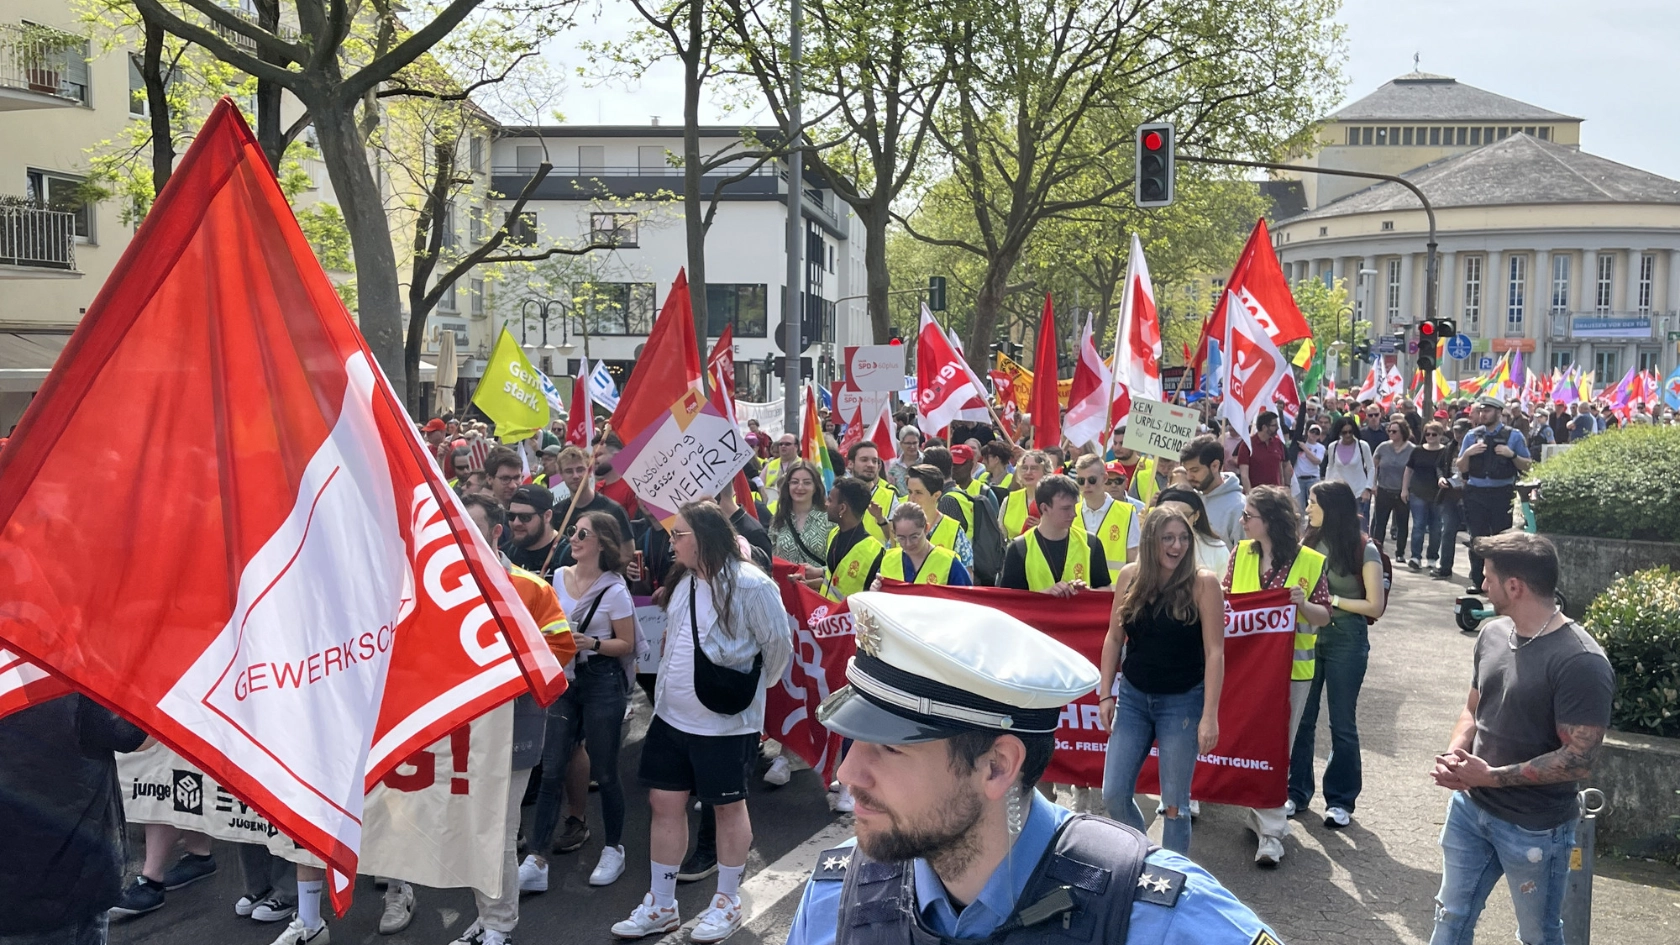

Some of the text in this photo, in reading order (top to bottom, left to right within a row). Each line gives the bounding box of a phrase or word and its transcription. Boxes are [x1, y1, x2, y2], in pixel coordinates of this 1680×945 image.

[503, 381, 539, 412] stark.
[1133, 401, 1153, 414] KEIN
[645, 443, 705, 498] besser und
[817, 614, 852, 636] JUSOS
[1229, 607, 1292, 635] JUSOS
[234, 620, 397, 702] GEWERKSCH
[1055, 738, 1073, 750] ÖG.
[1075, 741, 1108, 752] FREIZ
[132, 777, 171, 801] junge
